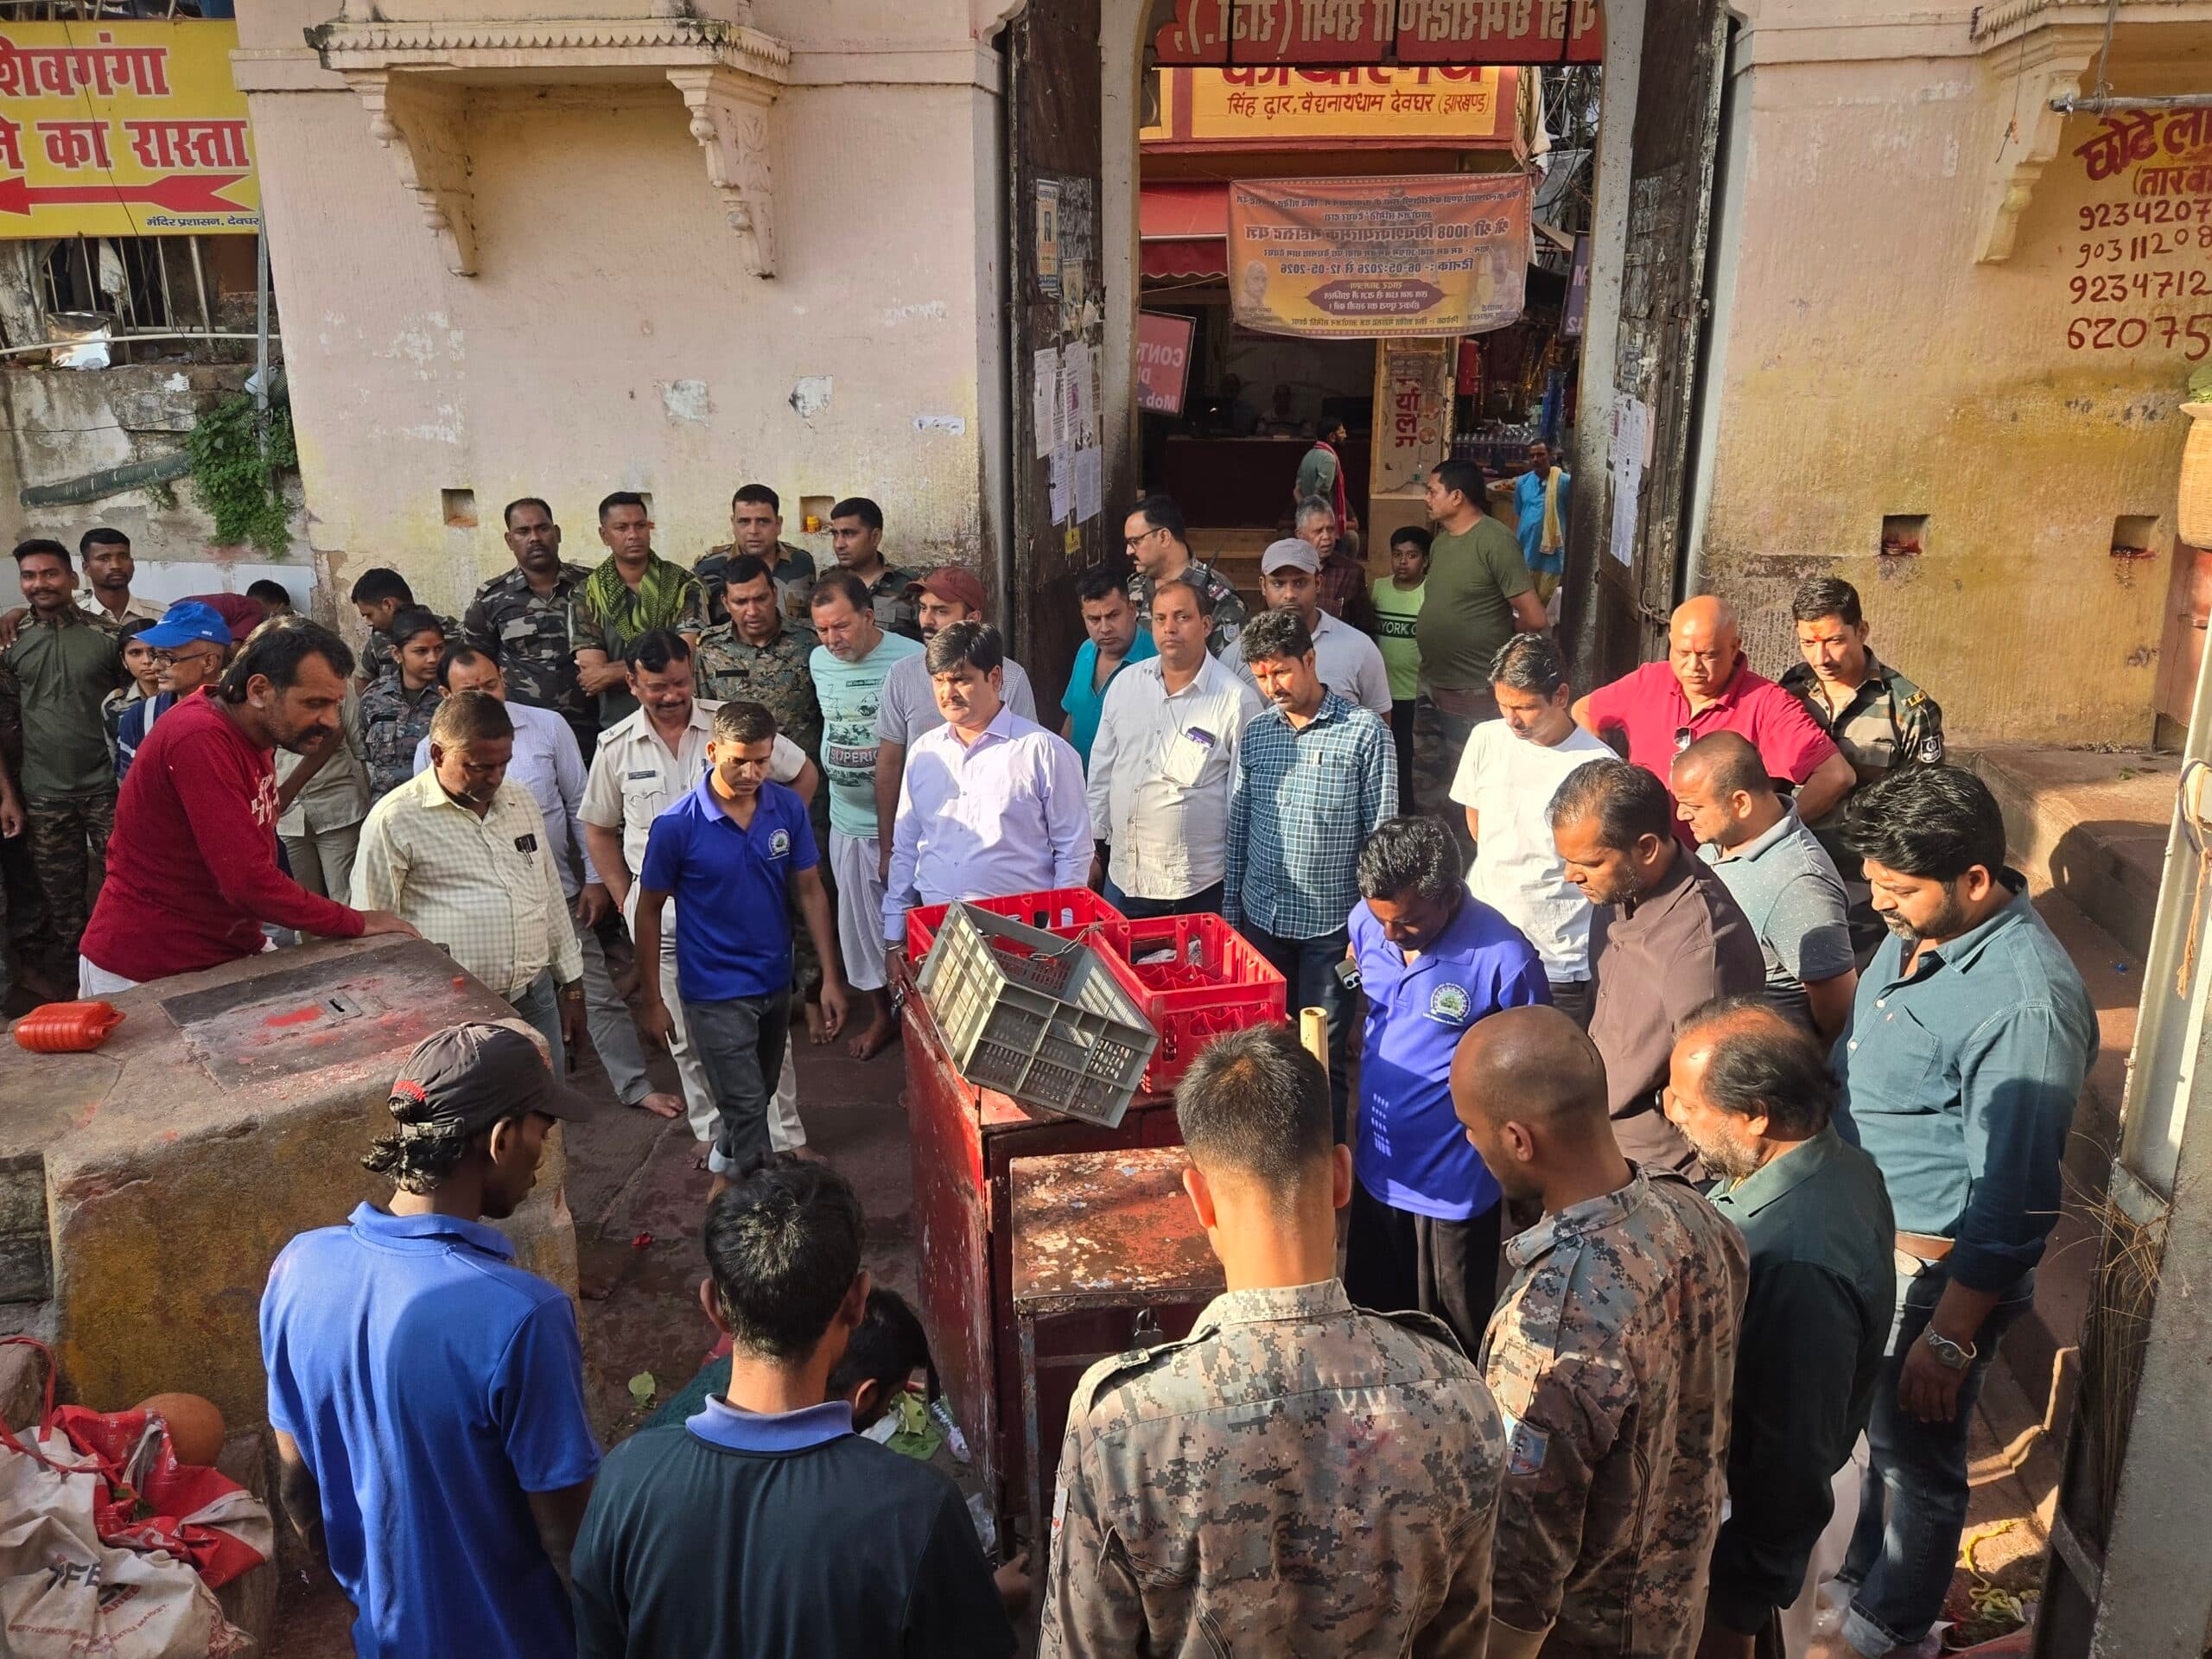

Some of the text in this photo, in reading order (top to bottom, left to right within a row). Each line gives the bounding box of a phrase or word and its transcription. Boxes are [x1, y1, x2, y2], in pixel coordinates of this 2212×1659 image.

[1227, 92, 1258, 118] सिंह
[1390, 89, 1435, 112] देवघर
[37, 122, 111, 168] का
[124, 120, 251, 168] रास्ता
[146, 216, 175, 226] मंदिर
[227, 214, 259, 226] देवघर
